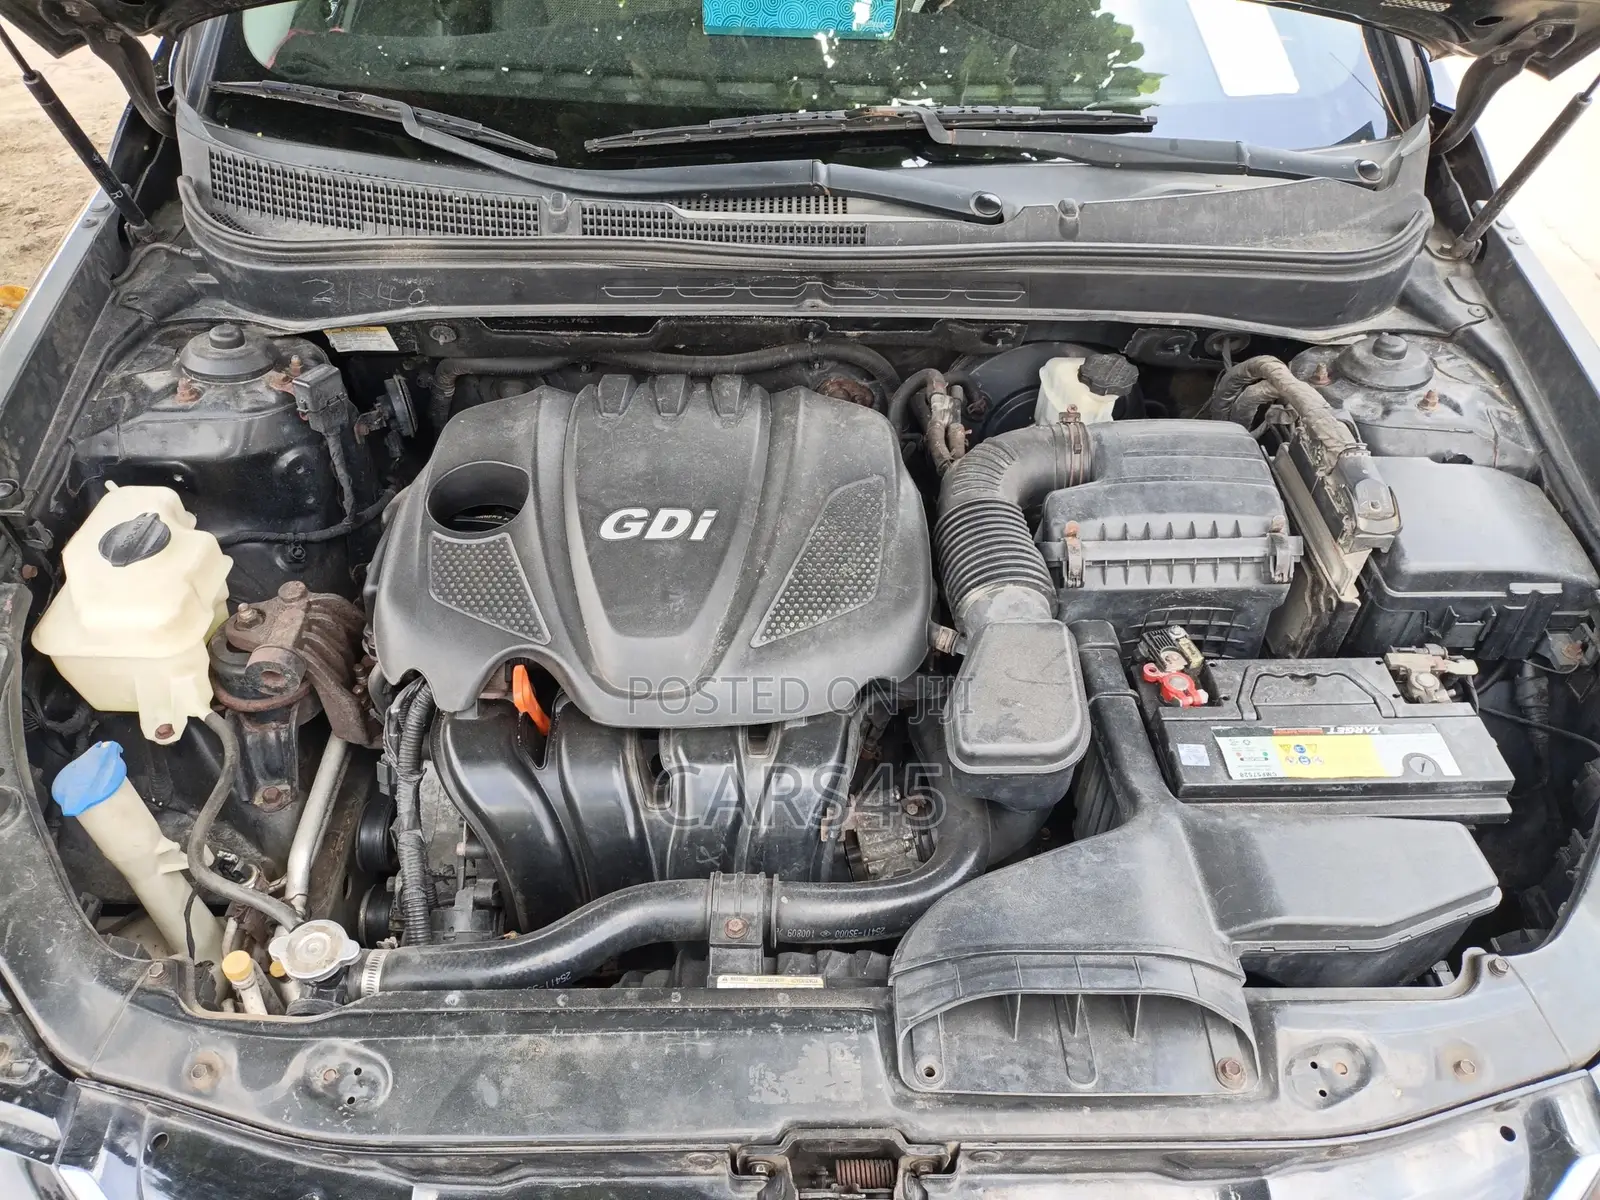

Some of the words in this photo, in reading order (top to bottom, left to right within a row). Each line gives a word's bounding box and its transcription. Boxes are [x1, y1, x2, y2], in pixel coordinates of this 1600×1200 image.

[110, 190, 123, 200] R
[599, 507, 719, 541] GDi
[1327, 726, 1381, 735] TARGET
